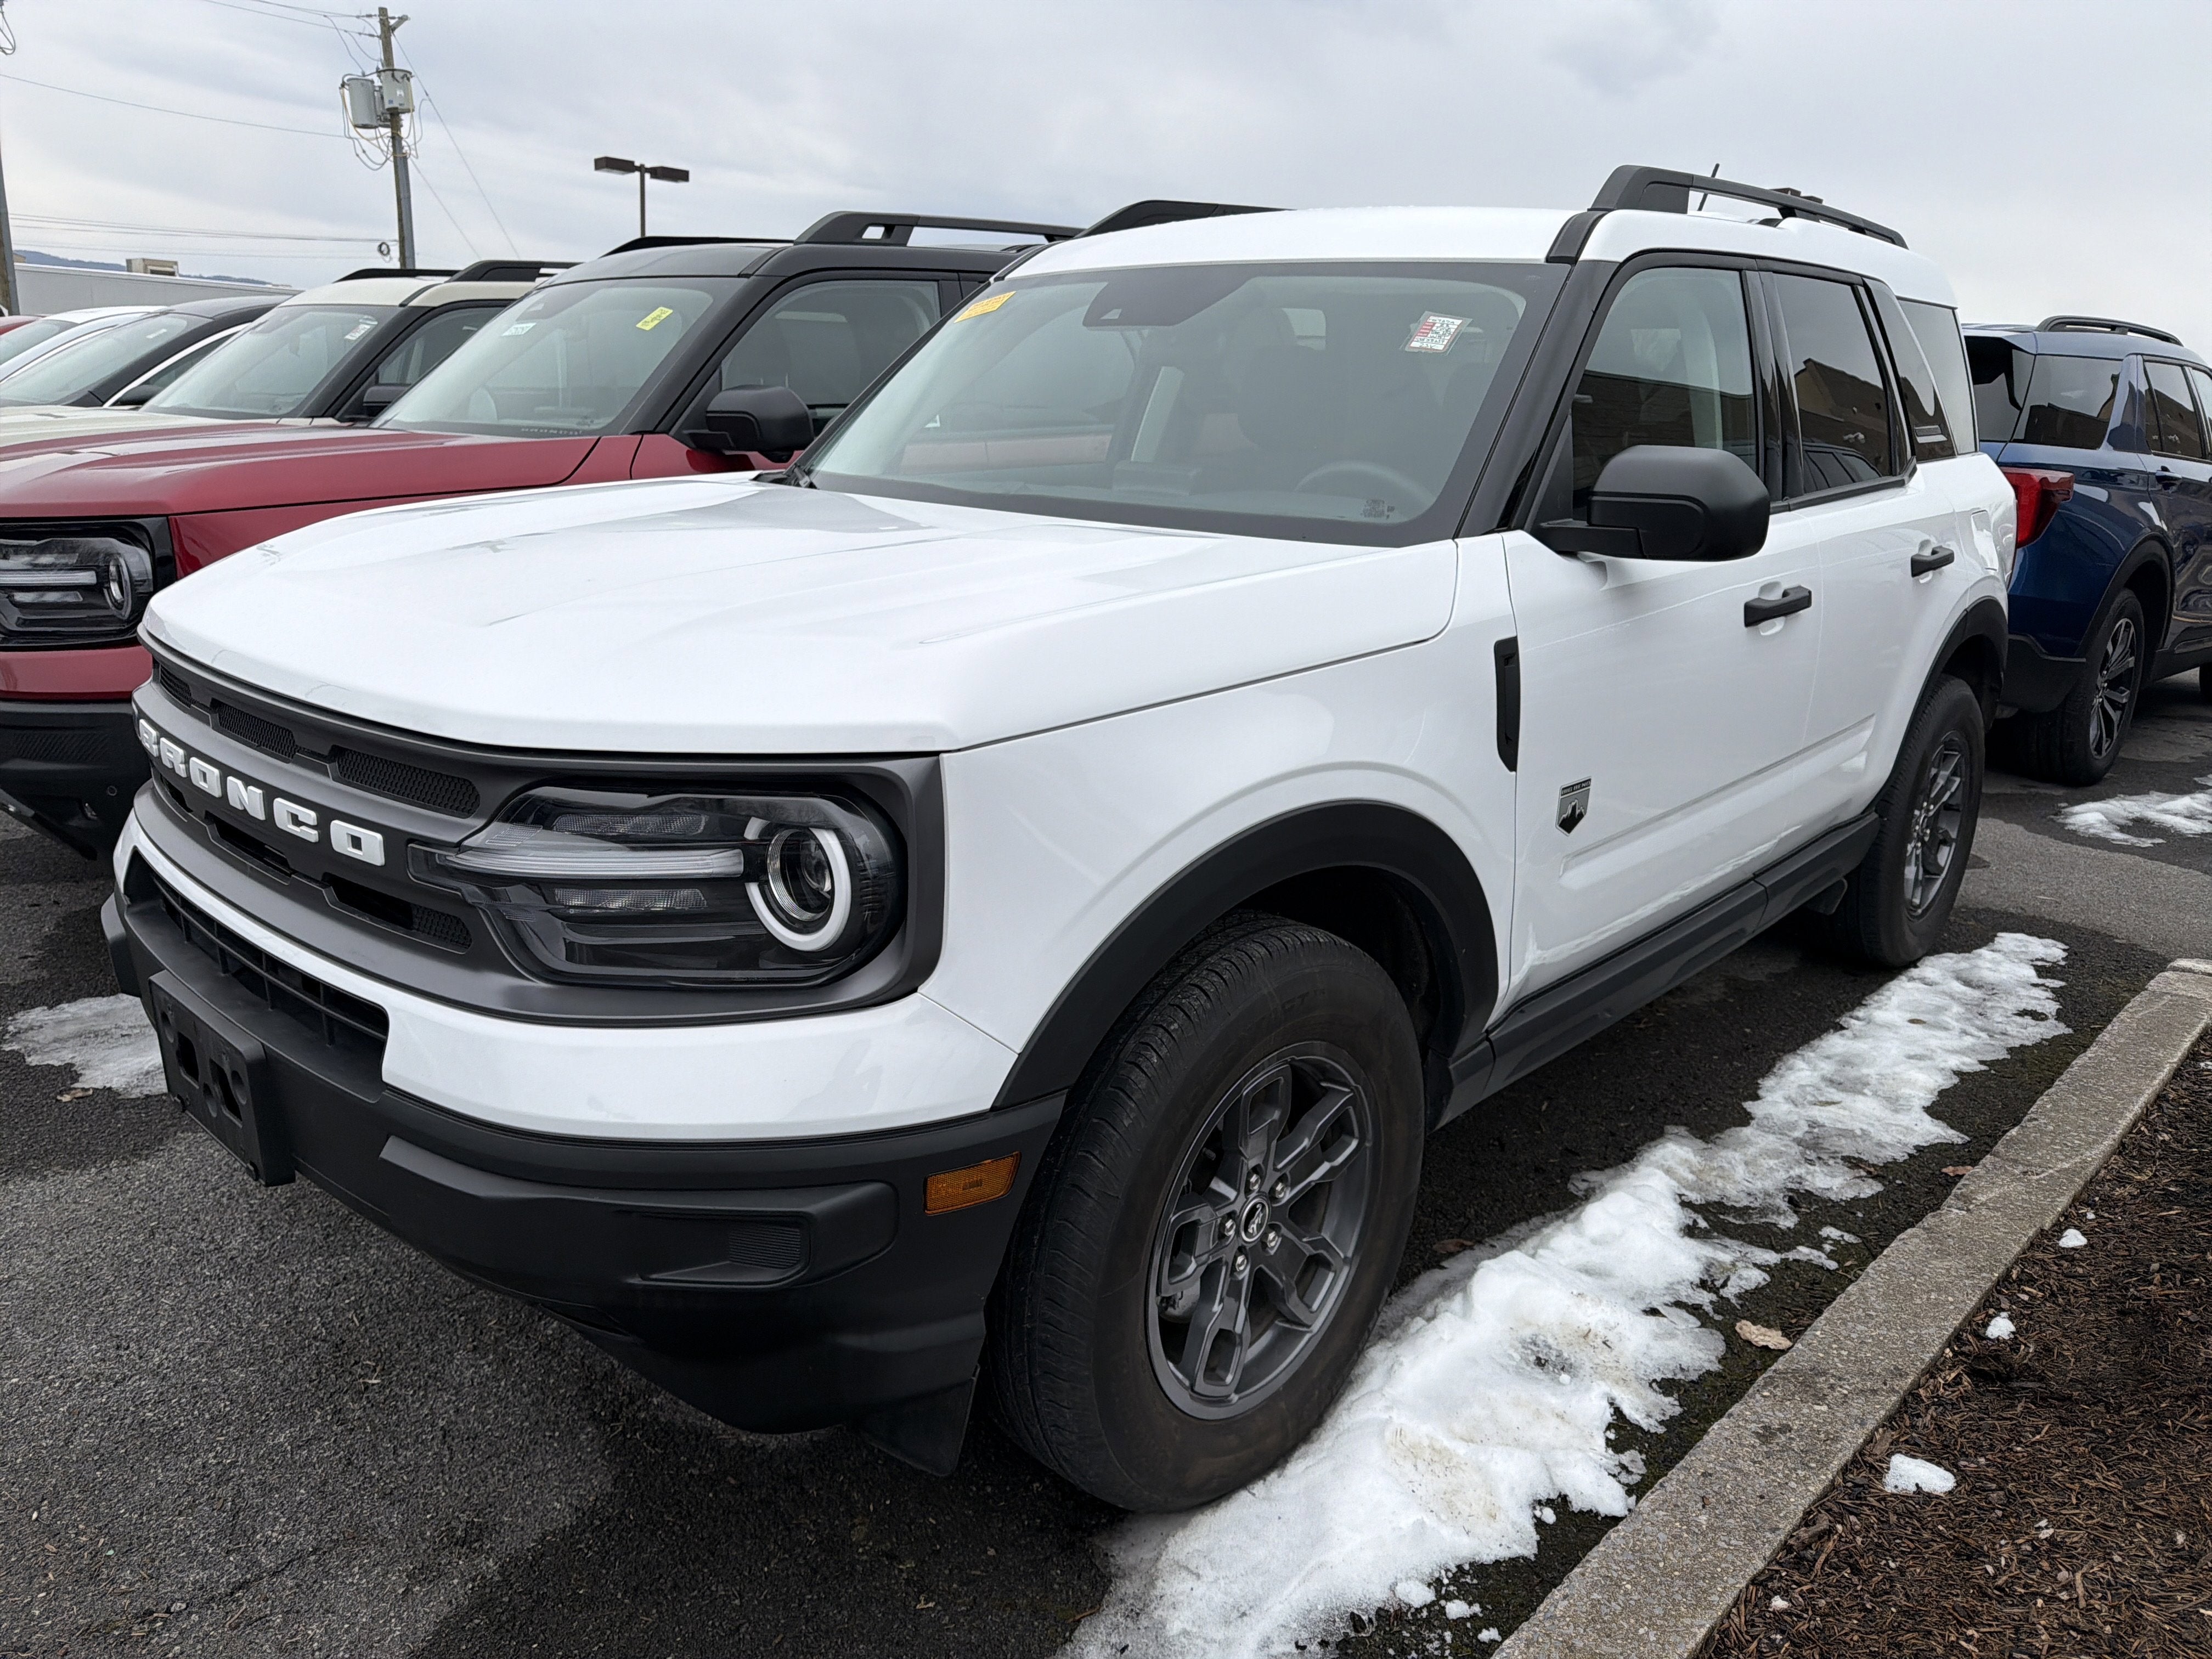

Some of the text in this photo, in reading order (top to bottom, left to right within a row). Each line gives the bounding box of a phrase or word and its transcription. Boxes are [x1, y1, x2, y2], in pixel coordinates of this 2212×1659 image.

[139, 719, 385, 866] BRONCO
[1561, 781, 1591, 794] BIG BEND
